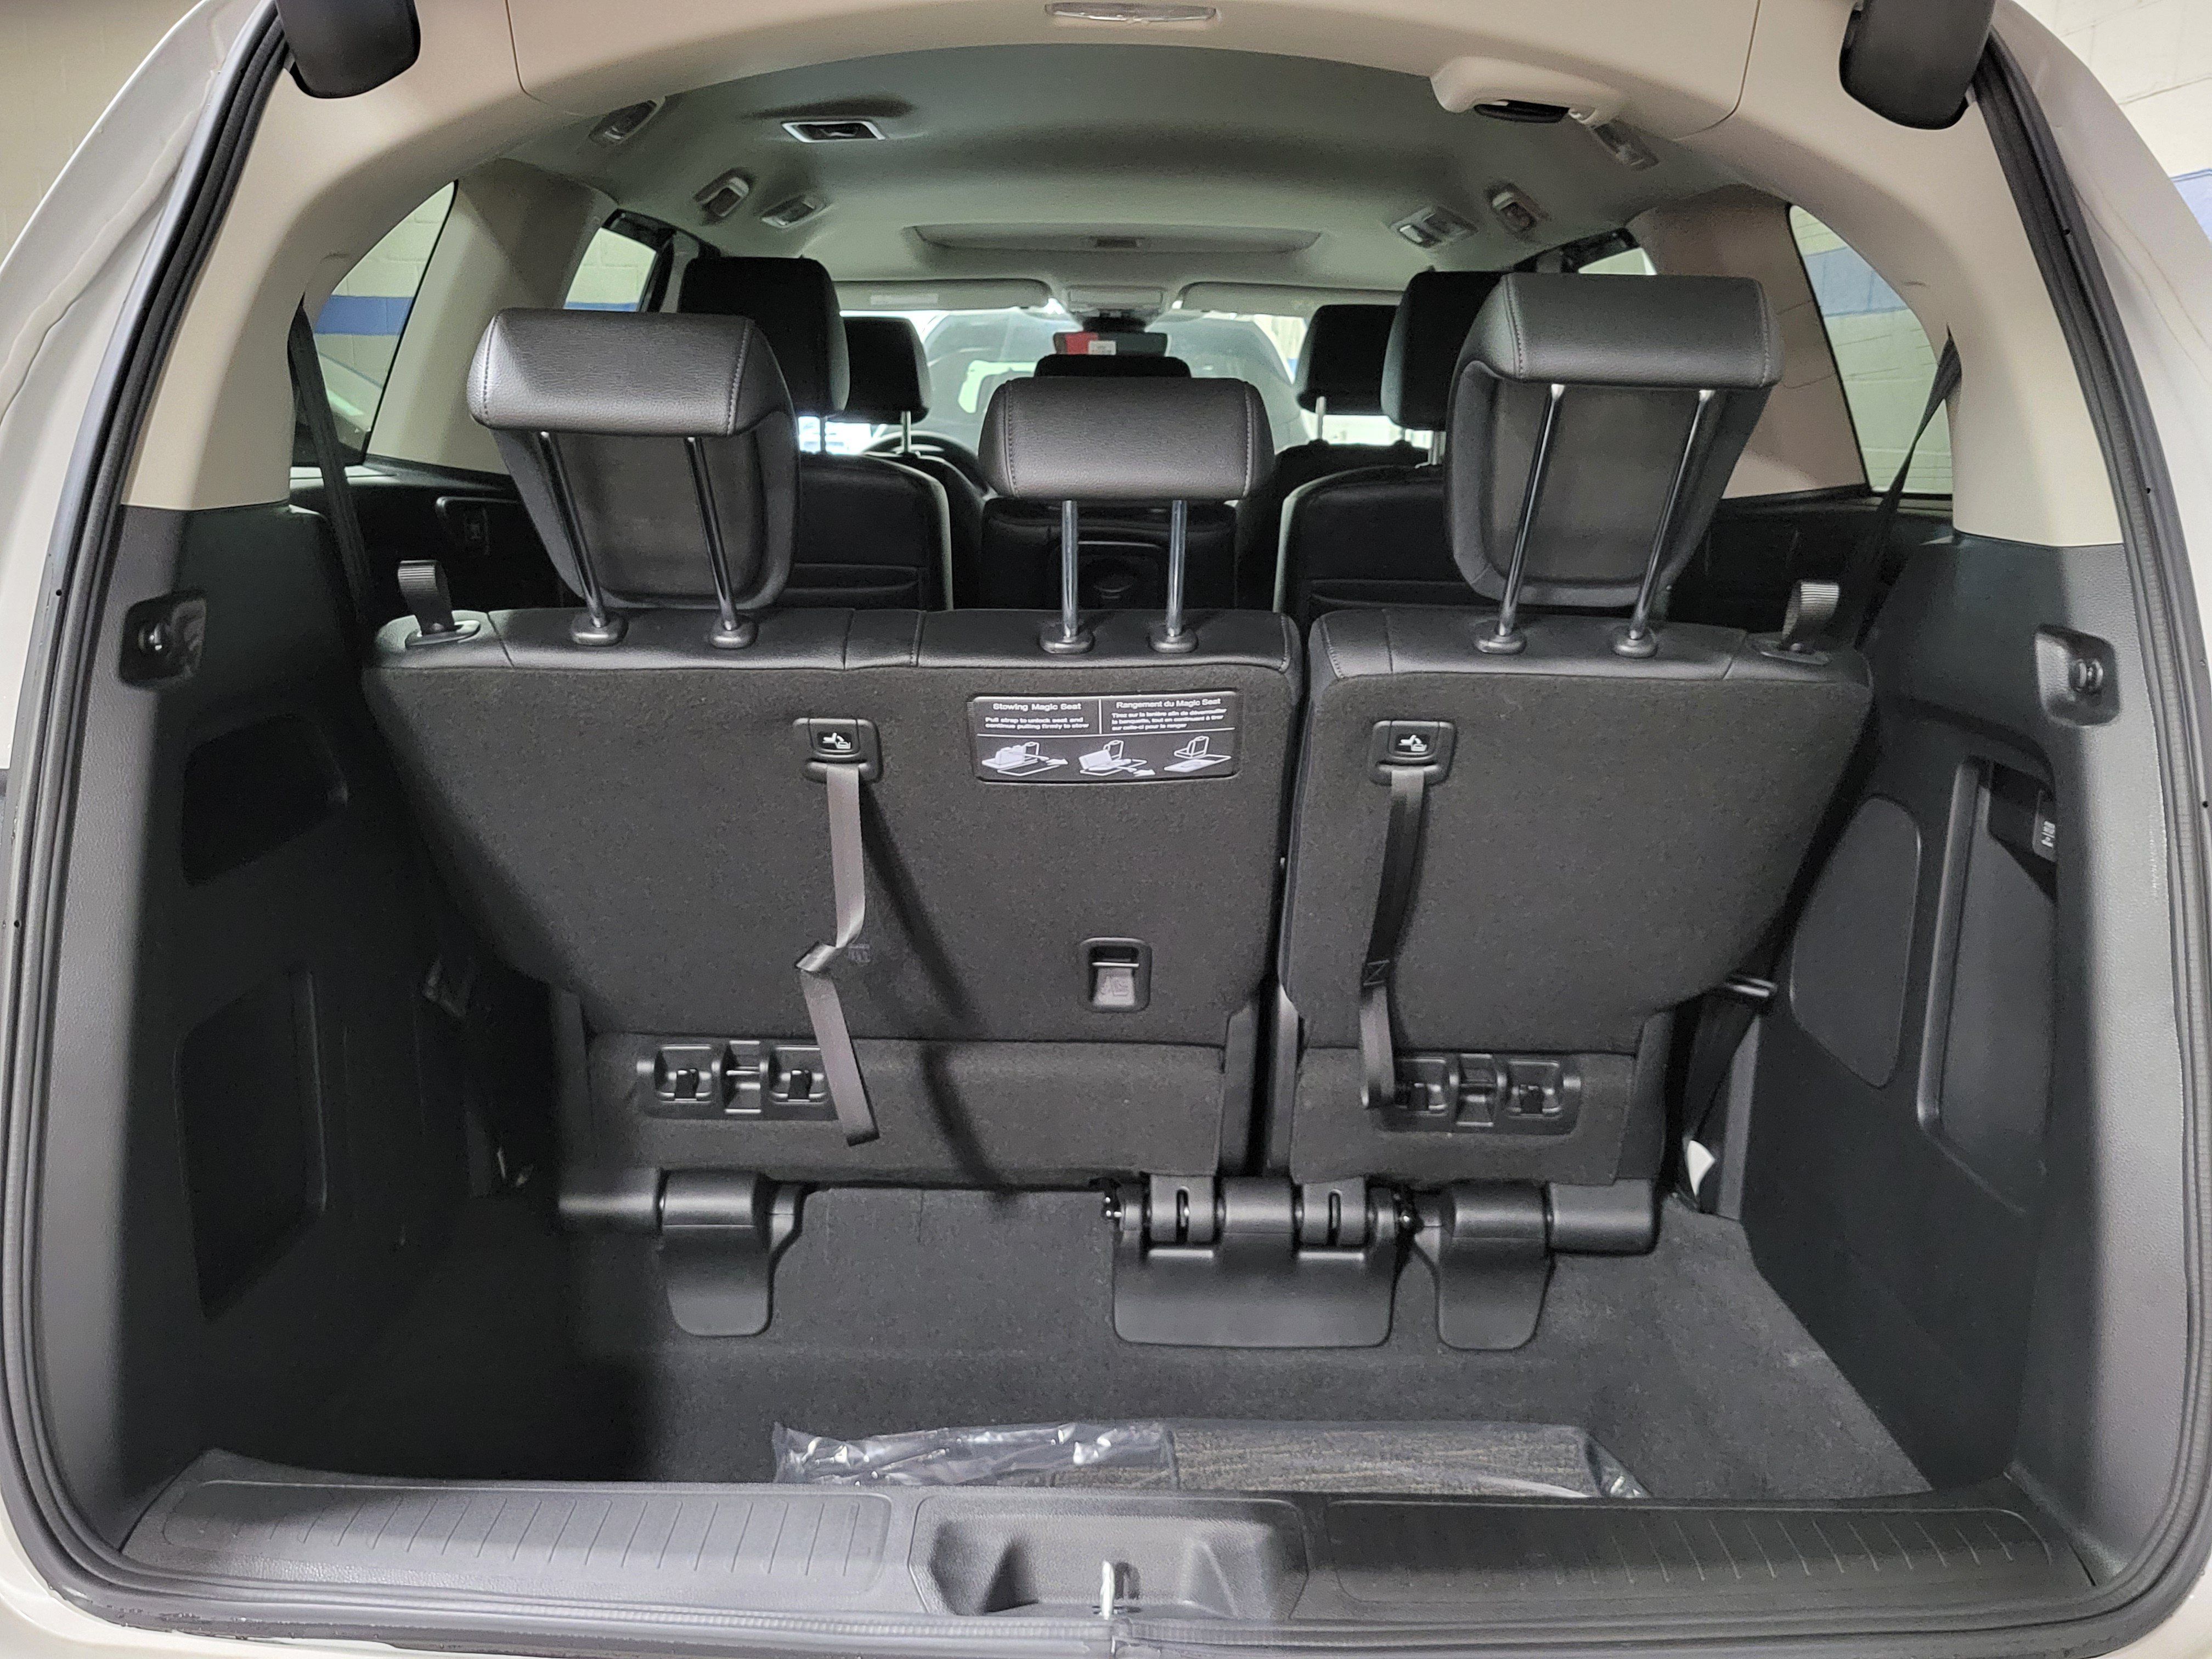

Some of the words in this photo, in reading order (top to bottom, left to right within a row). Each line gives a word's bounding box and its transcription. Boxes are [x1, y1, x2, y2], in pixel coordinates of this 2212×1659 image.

[992, 703, 1029, 712] Stowing
[1031, 703, 1058, 712] Magic
[1116, 701, 1163, 709] Rangement
[1176, 699, 1201, 708] Magic
